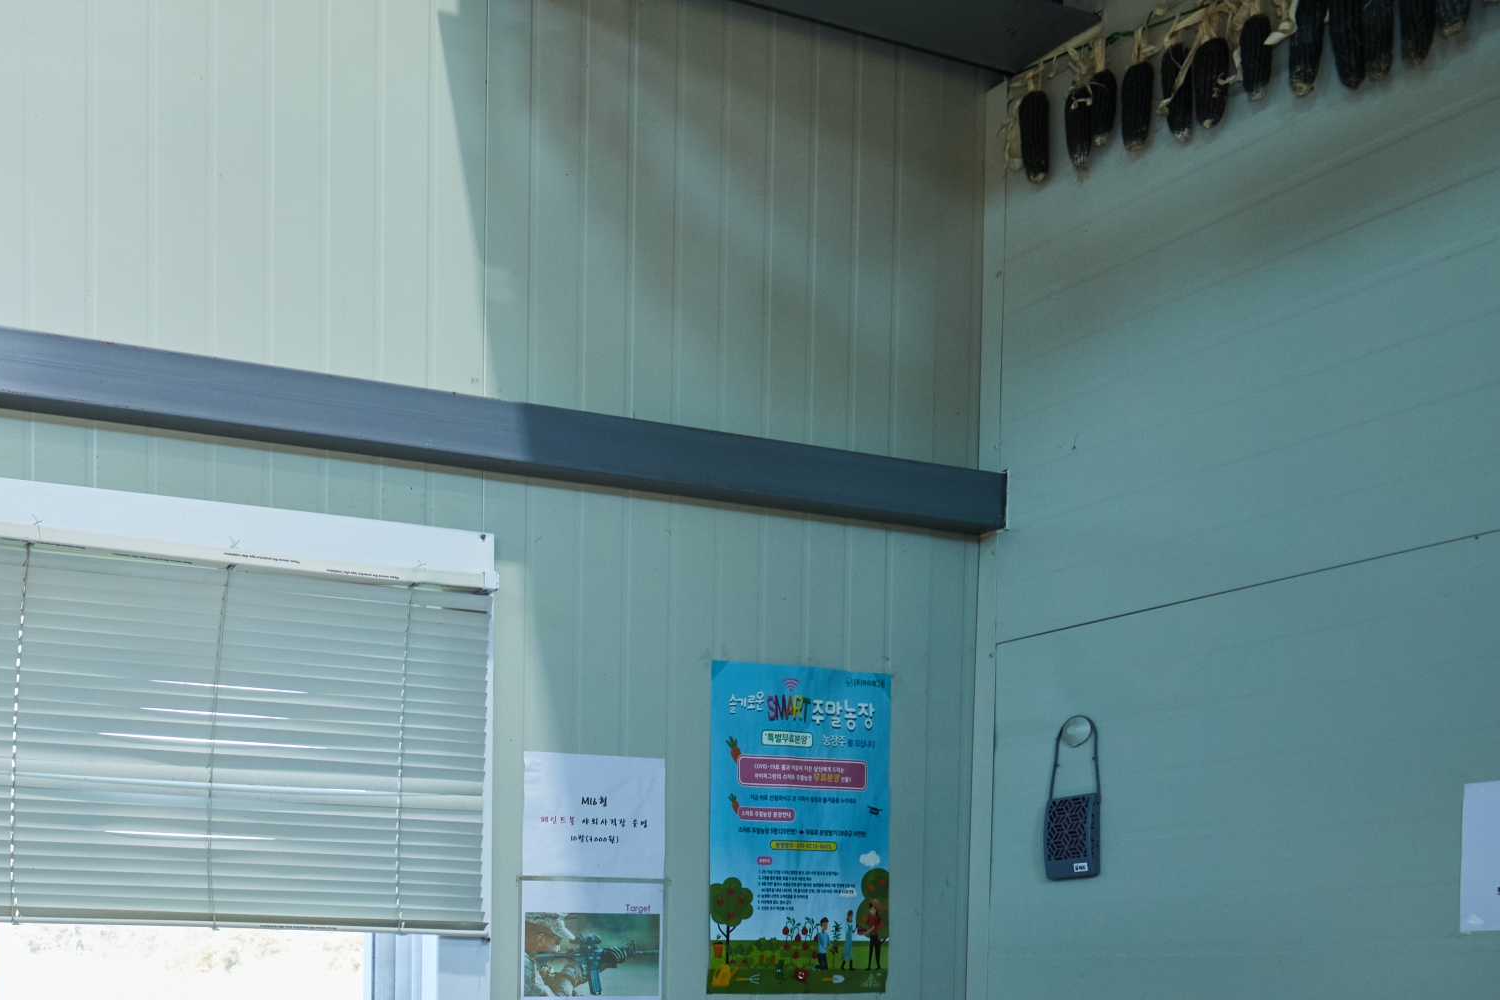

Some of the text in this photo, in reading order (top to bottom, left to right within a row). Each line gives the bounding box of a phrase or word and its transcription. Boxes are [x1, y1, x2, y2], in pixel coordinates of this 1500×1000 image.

[729, 691, 875, 732] 슬기로운 SMART 주말농장
[814, 774, 840, 783] 무료분양
[581, 818, 626, 827] 야외사격장
[625, 904, 650, 913] Target
